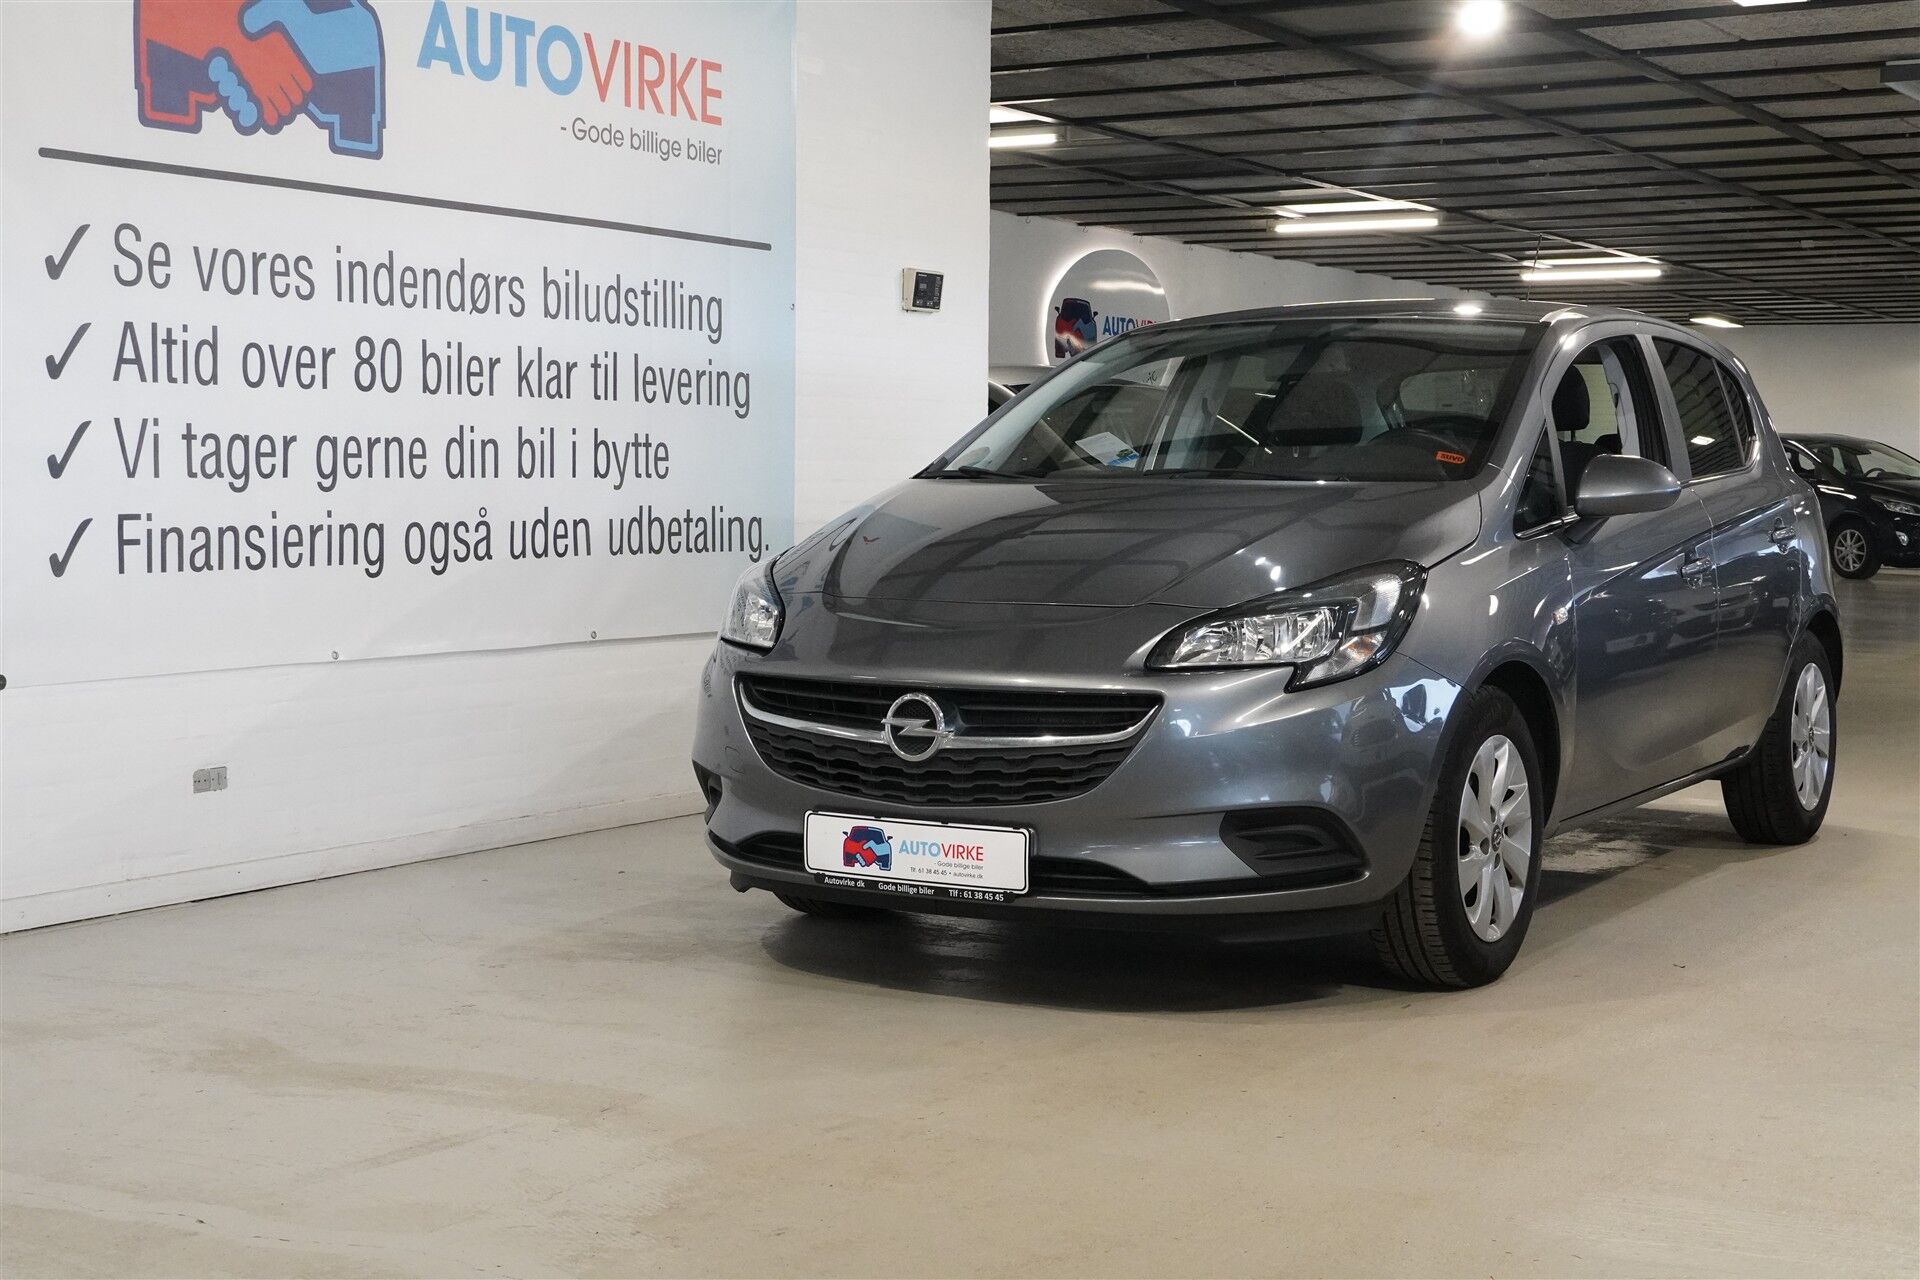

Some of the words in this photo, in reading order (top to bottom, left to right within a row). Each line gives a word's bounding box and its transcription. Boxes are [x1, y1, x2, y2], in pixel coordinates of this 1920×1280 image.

[416, 0, 722, 126] AUTOVIRKE
[571, 117, 625, 148] Gode
[630, 127, 682, 162] billige
[687, 137, 723, 166] biler
[113, 222, 171, 290] Se
[192, 245, 316, 301] vores
[335, 245, 526, 318] indendørs
[543, 266, 723, 345] biludstilling
[112, 320, 219, 387] Altid
[242, 342, 336, 390] over
[353, 335, 403, 394] 80
[421, 338, 501, 397] biler
[517, 345, 578, 401] klar
[590, 351, 618, 402] til
[633, 352, 751, 420] levering
[113, 417, 160, 479] Vi
[181, 422, 298, 494] tager
[315, 434, 427, 493] gerne
[445, 424, 499, 480] din
[517, 425, 555, 480] bil
[571, 427, 577, 479] i
[593, 427, 670, 491] bytte
[117, 509, 385, 579] Finansiering
[404, 506, 493, 576] også
[509, 506, 592, 561] uden
[608, 504, 770, 564] udbetaling.
[898, 839, 984, 862] AUTOVIRKE
[937, 860, 953, 868] Gode
[953, 862, 971, 870] billige
[824, 876, 855, 887] Autovirke
[878, 882, 897, 892] Gode
[897, 883, 918, 895] billige
[918, 885, 935, 895] biler
[948, 889, 958, 897] Tlf
[963, 890, 973, 899] 61
[973, 891, 983, 900] 38
[984, 892, 994, 901] 45
[994, 893, 1004, 902] 45
